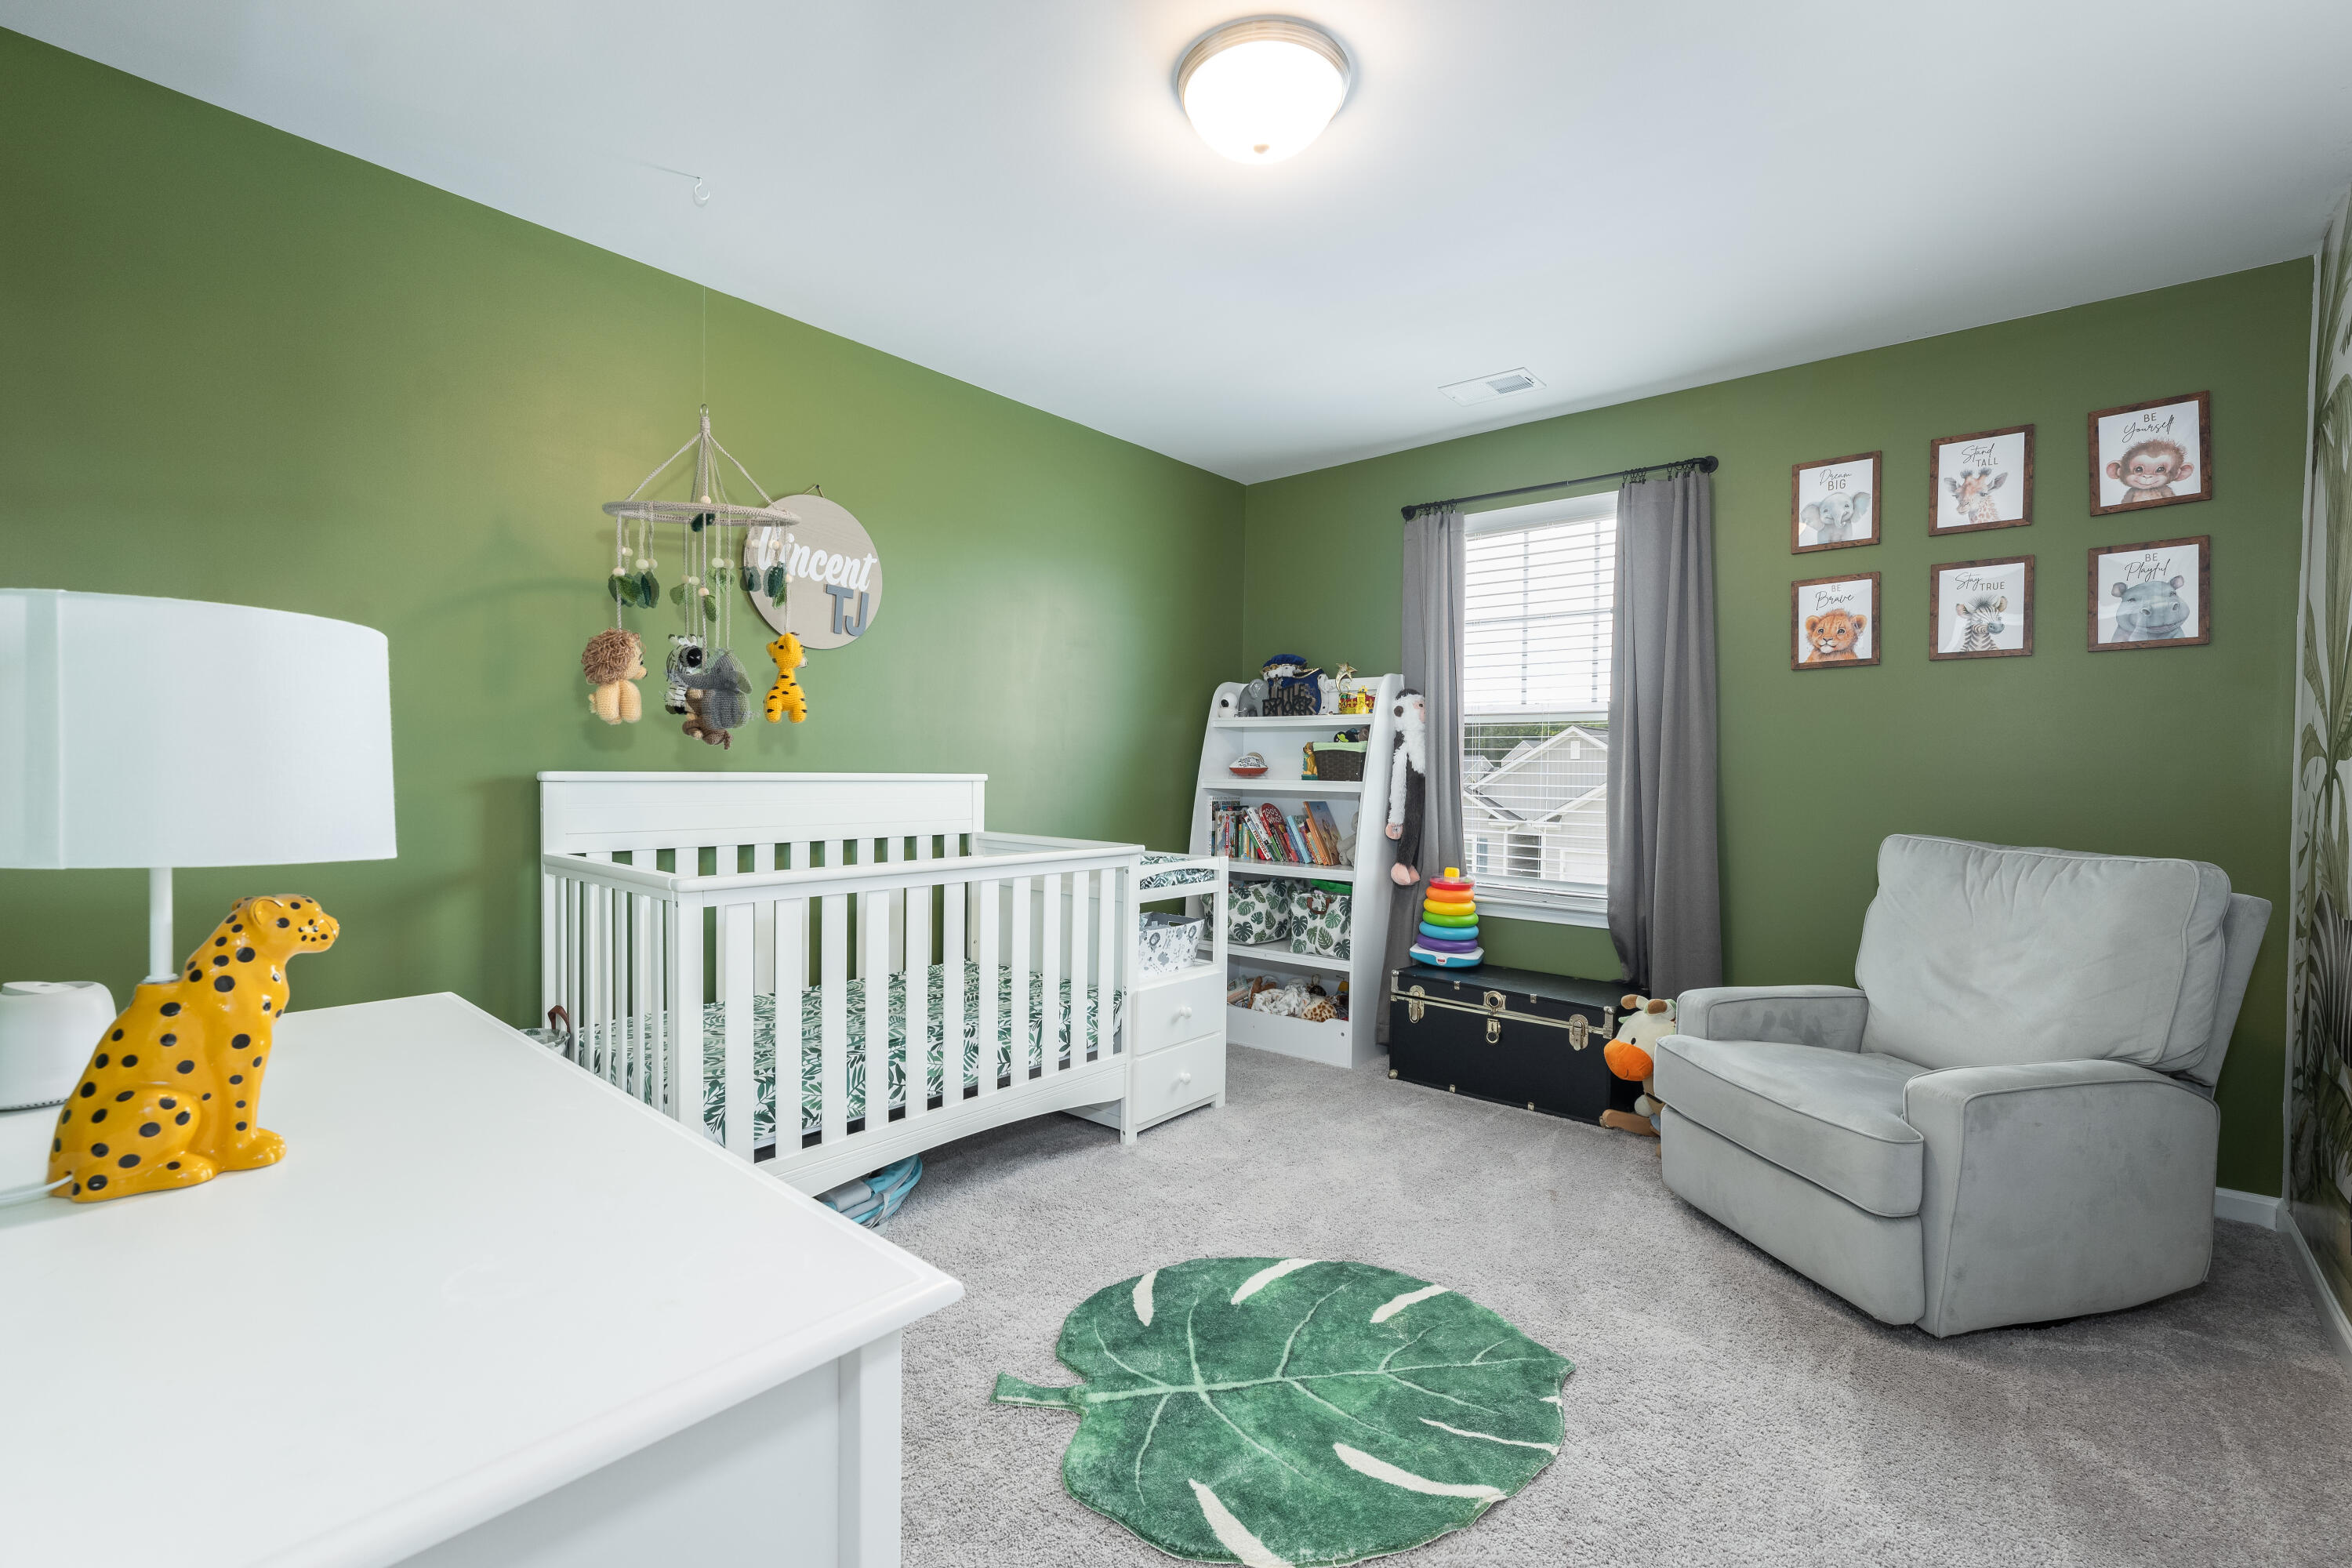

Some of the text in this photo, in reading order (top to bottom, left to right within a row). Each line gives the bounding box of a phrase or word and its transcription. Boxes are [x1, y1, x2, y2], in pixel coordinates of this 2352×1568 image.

[2143, 412, 2158, 423] BE
[2122, 414, 2175, 443] Yourself
[1961, 442, 1995, 463] Stand
[1975, 457, 1999, 467] TALL
[1819, 468, 1852, 486] Dream
[1828, 478, 1846, 491] BIG
[2145, 553, 2158, 562] BE
[2124, 558, 2171, 582] Playful
[1831, 584, 1842, 593] BE
[1955, 572, 2006, 591] Stay TRUE
[1815, 590, 1854, 611] Brave
[826, 583, 869, 637] TJ
